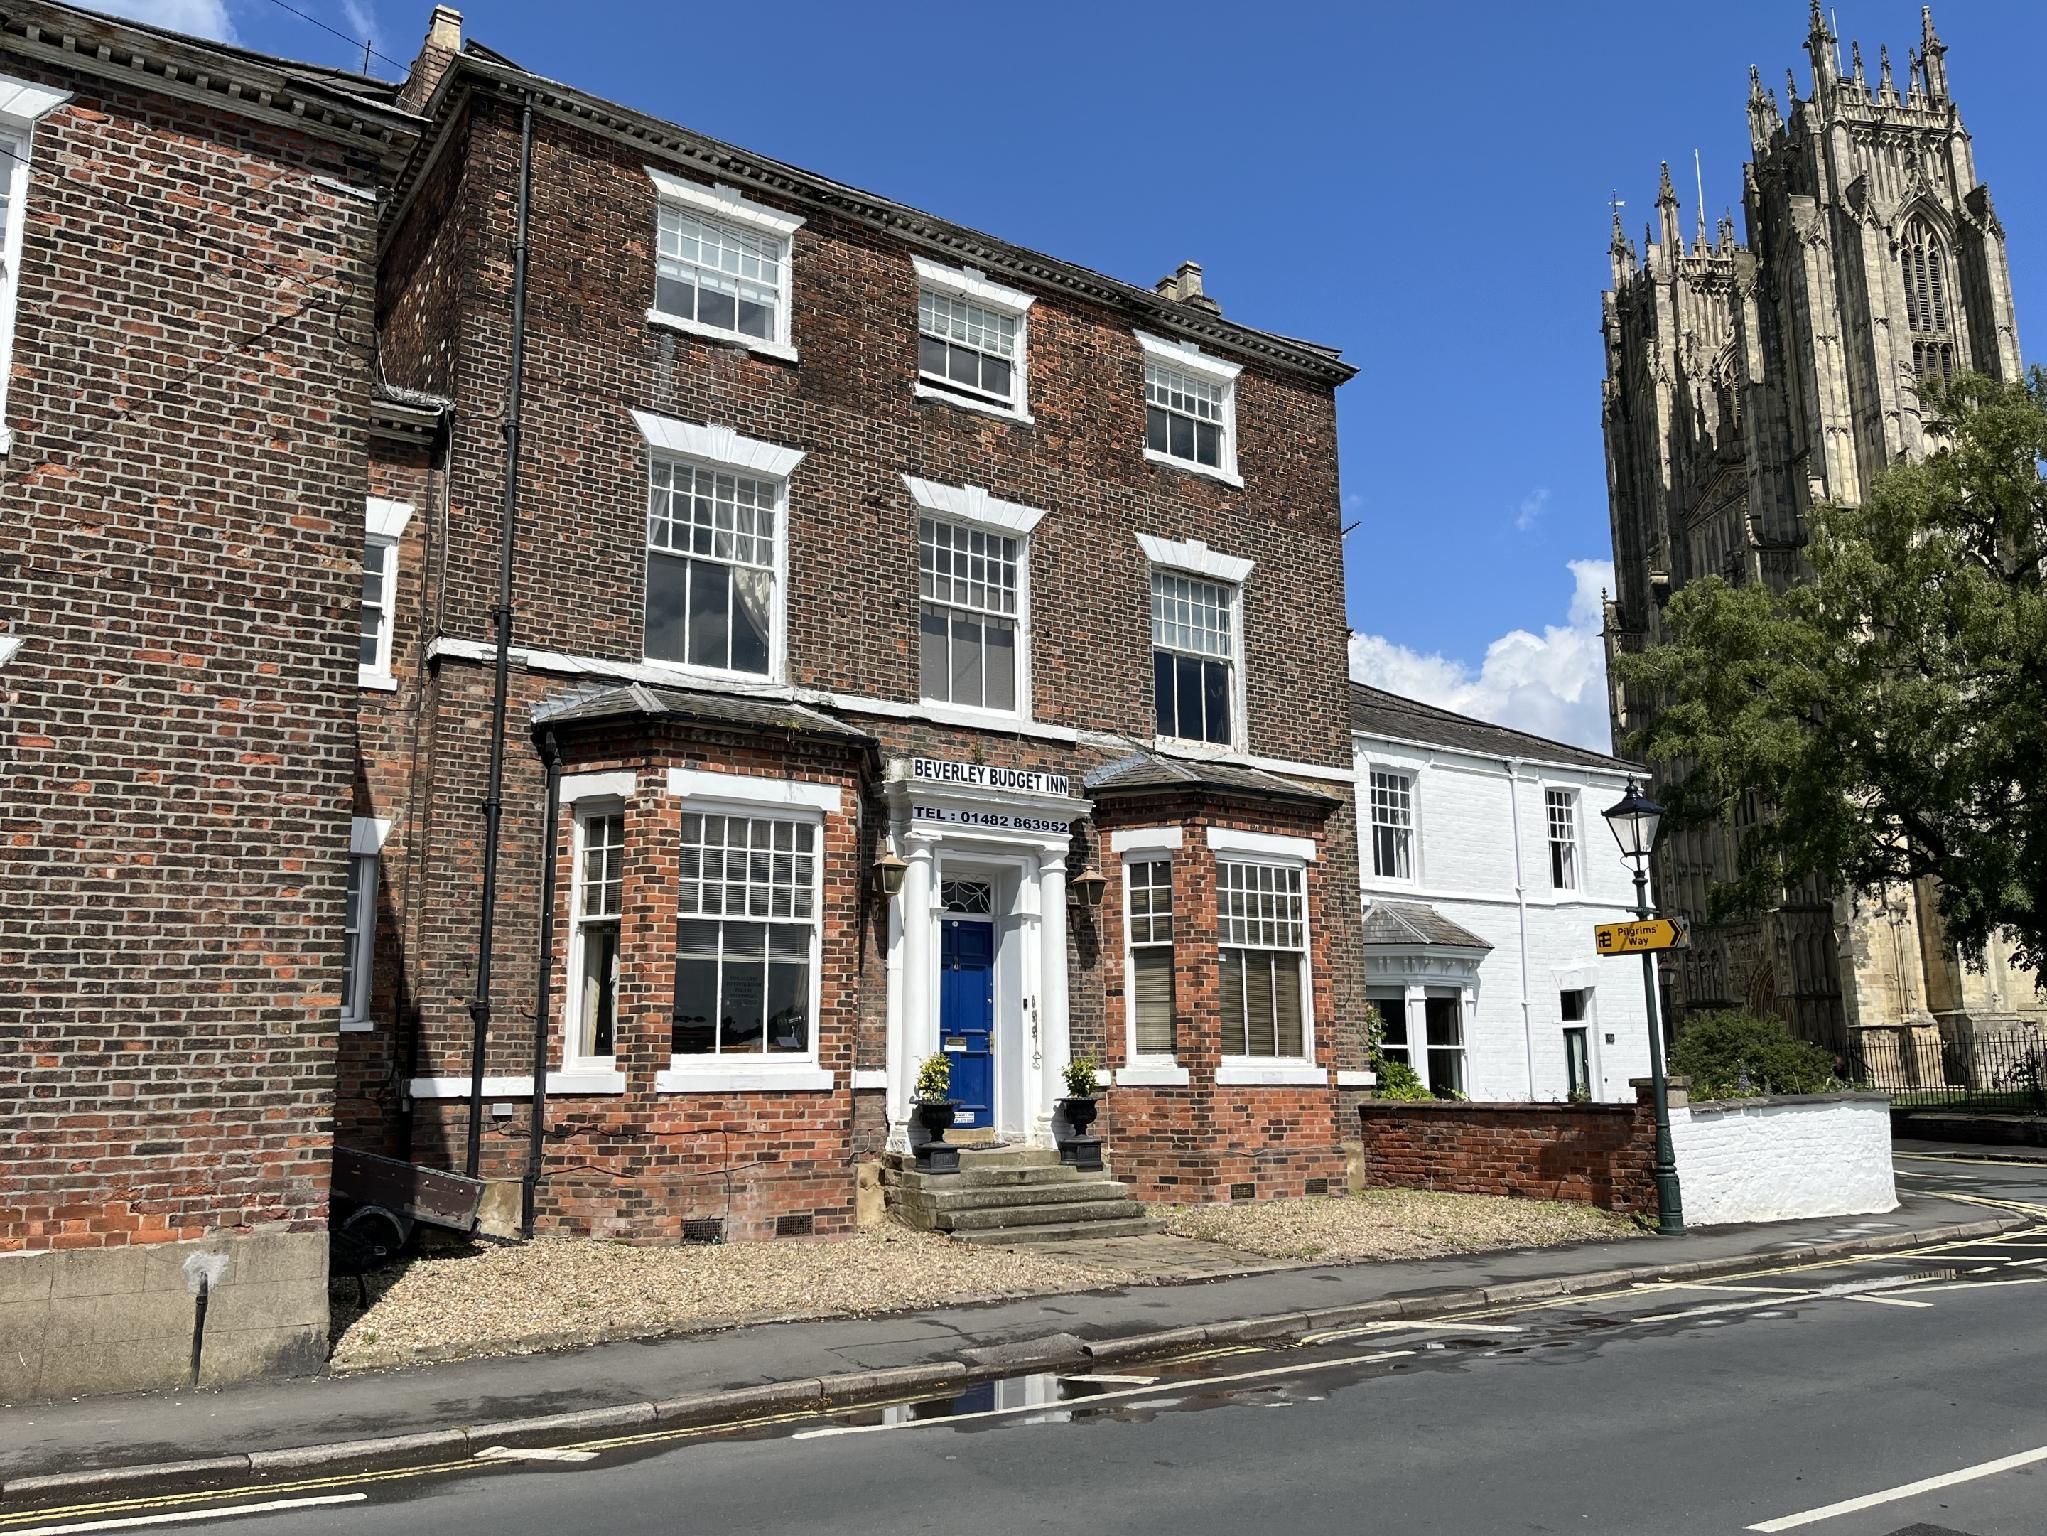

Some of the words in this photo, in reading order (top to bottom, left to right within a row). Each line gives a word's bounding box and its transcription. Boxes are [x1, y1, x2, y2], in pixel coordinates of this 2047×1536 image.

[914, 759, 985, 783] BEVERLEY
[990, 768, 1042, 790] BUDGET
[1046, 775, 1067, 794] INN
[960, 811, 1009, 826] 01482
[1013, 817, 1068, 833] 863952
[1617, 924, 1658, 937] Pilgrims'
[1628, 937, 1649, 946] Way
